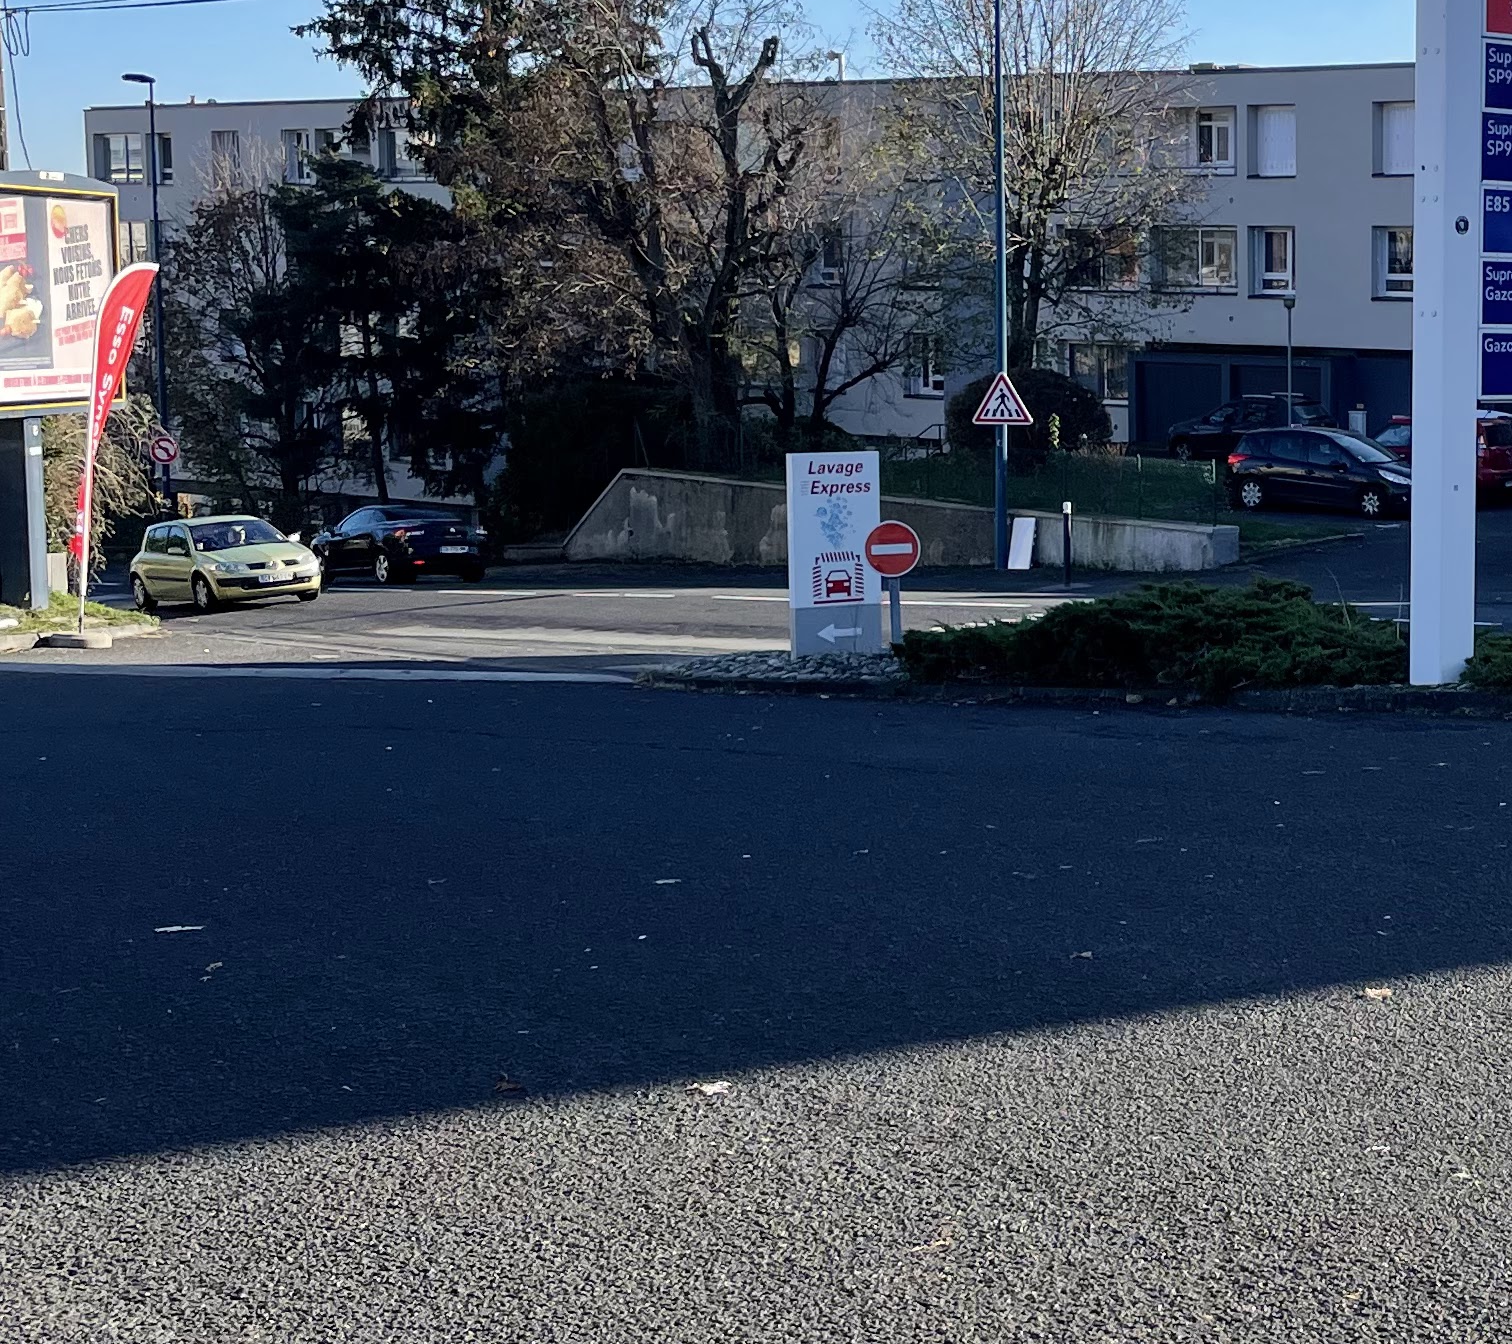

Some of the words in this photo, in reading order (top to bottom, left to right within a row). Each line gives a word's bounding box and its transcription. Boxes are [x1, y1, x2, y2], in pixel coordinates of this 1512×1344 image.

[1485, 195, 1511, 213] E85
[808, 461, 864, 477] Lavage
[810, 480, 871, 497] Express
